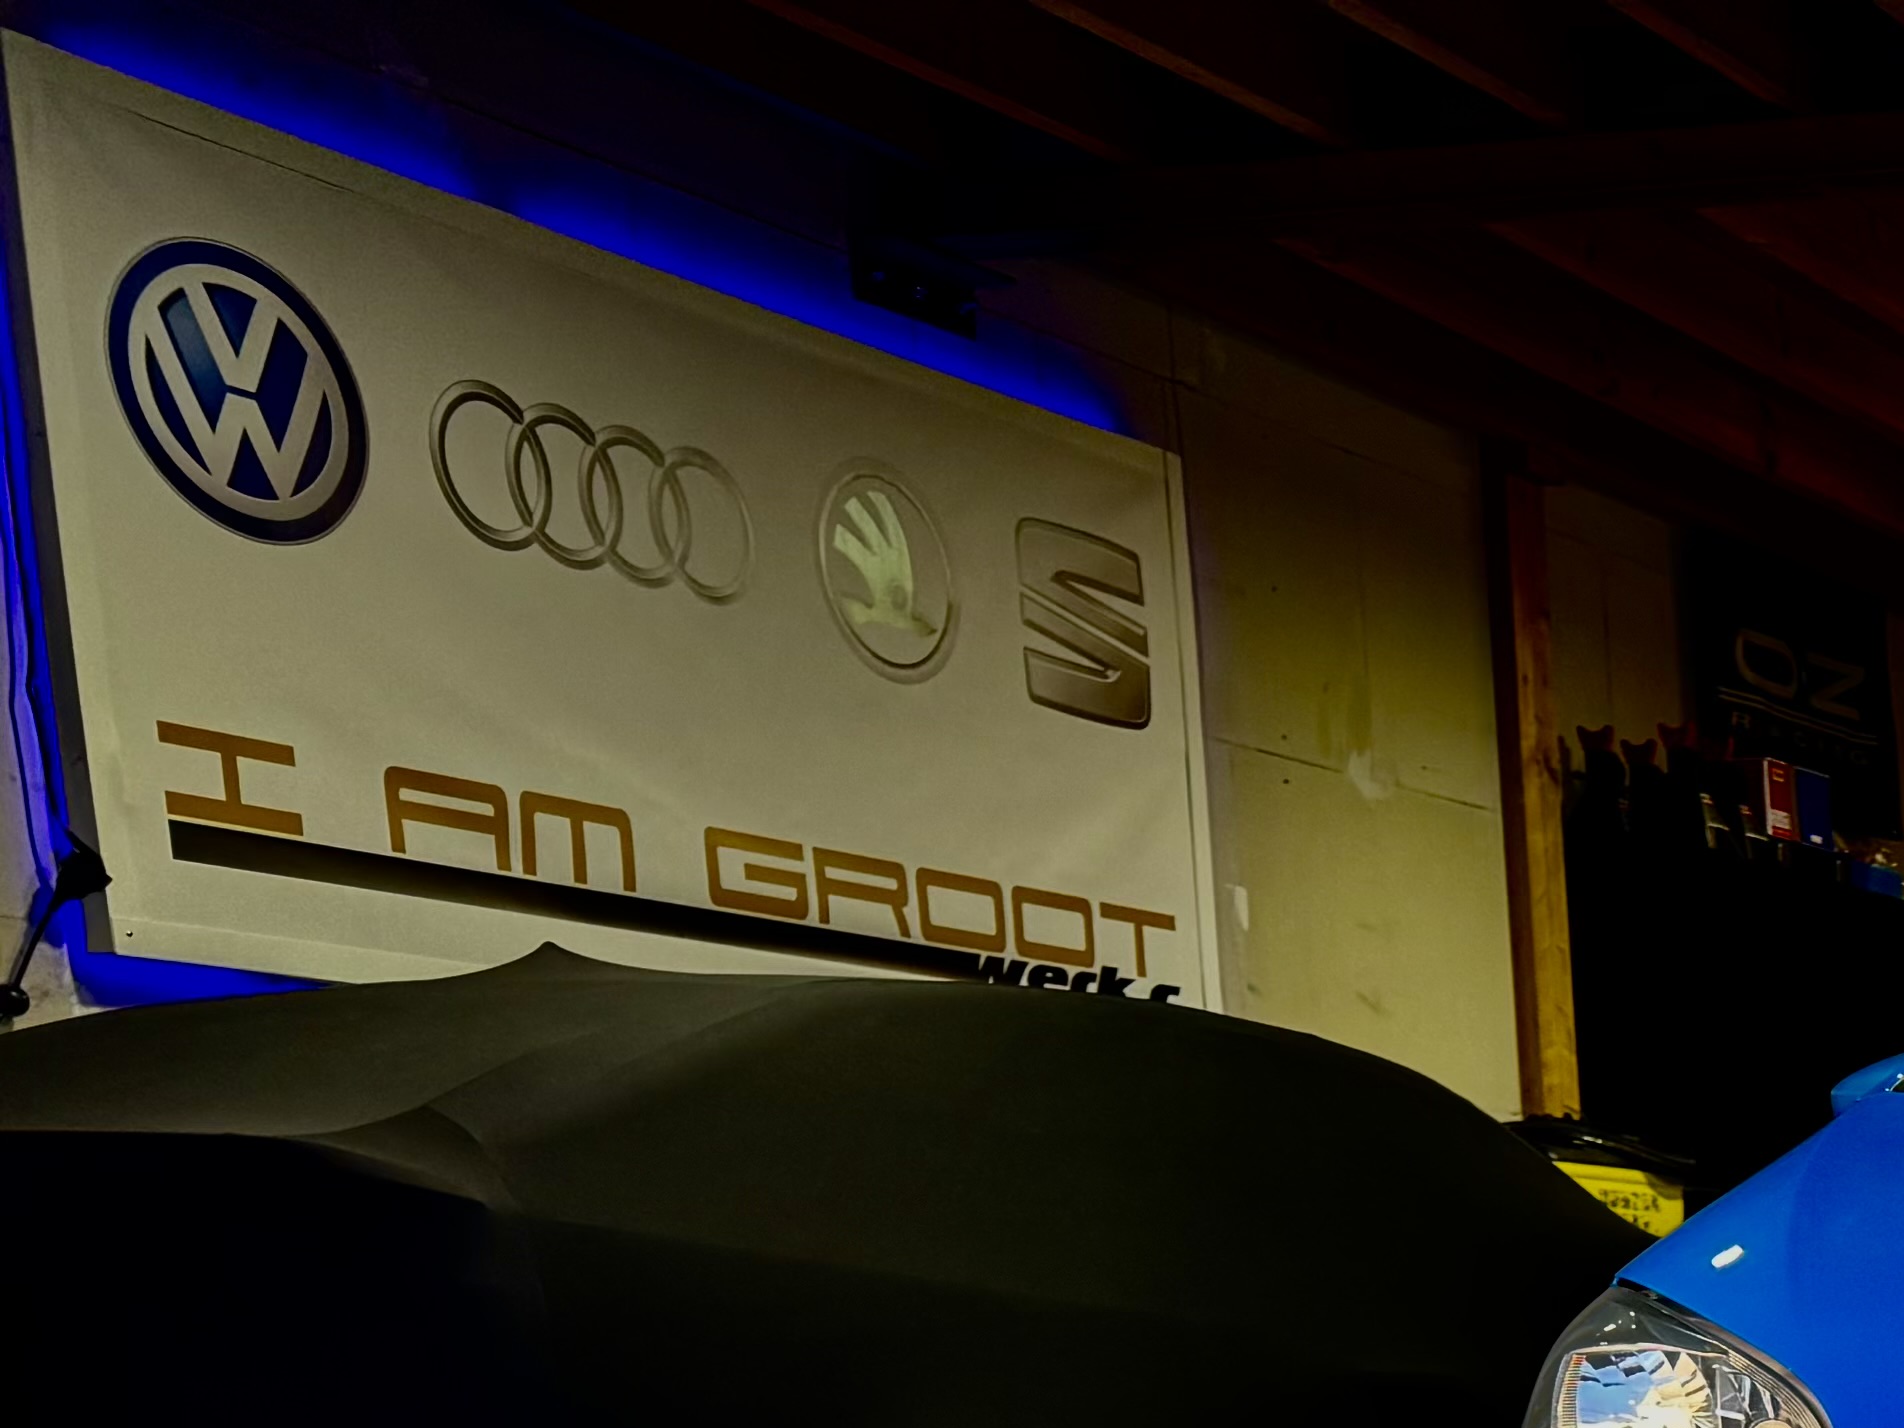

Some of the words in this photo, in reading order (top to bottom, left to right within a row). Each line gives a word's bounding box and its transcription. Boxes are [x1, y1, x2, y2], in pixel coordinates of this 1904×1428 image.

[156, 720, 304, 837] I
[384, 765, 637, 893] AM
[704, 826, 1177, 978] GROOT
